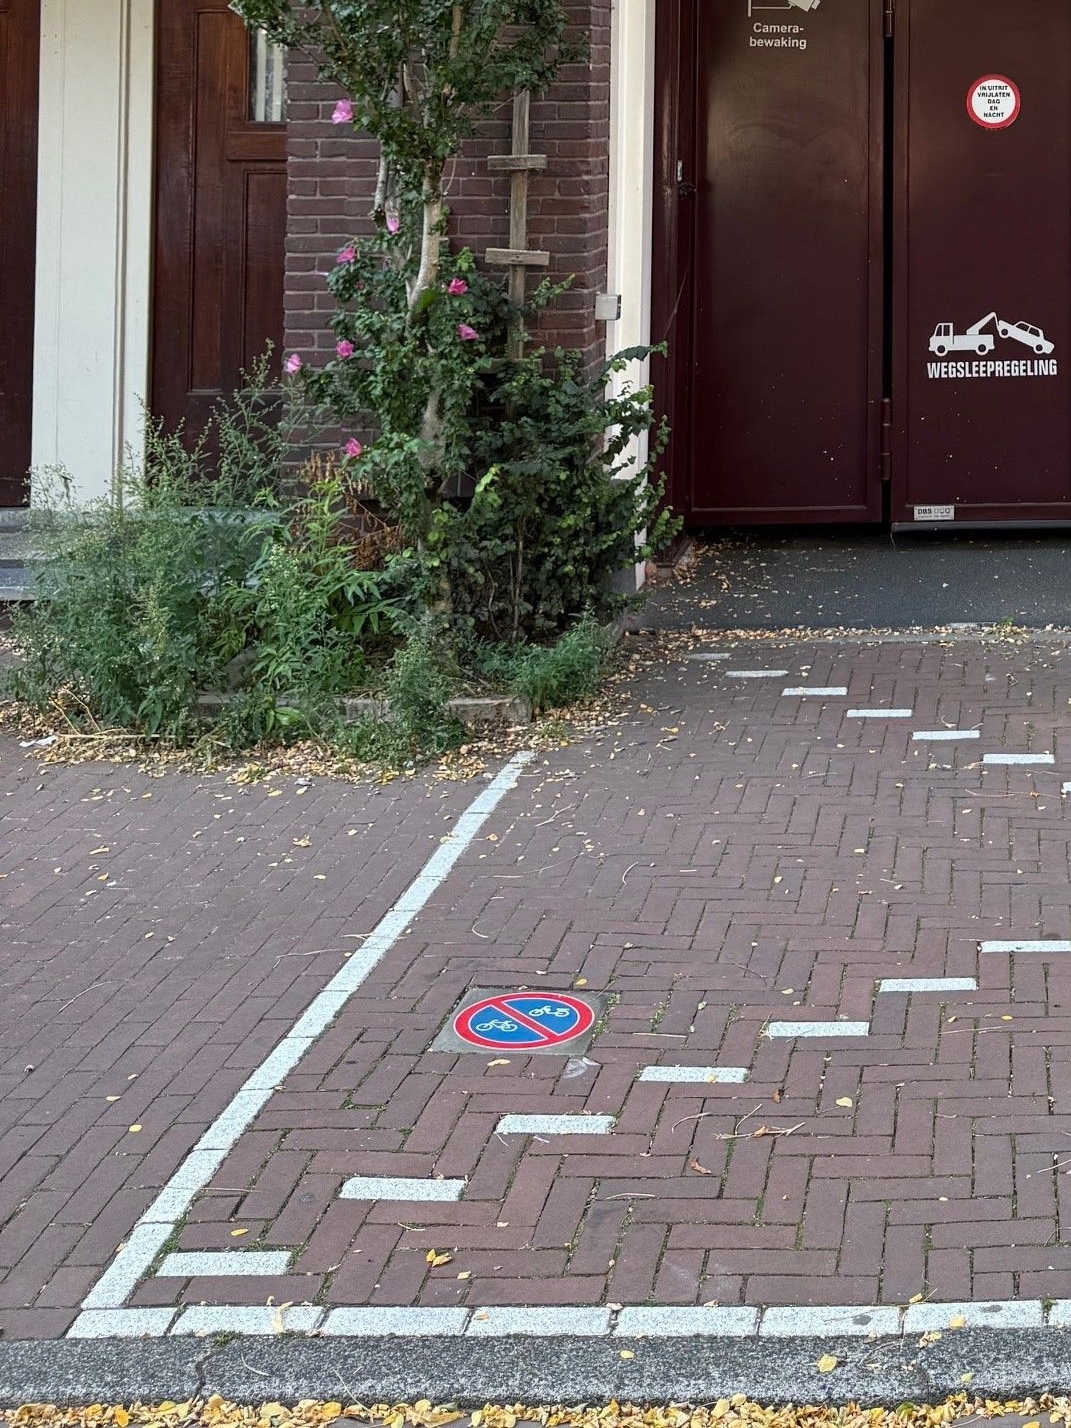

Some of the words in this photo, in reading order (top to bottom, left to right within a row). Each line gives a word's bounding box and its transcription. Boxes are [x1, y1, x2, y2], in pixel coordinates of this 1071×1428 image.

[753, 22, 804, 33] Camera-
[749, 36, 807, 50] bewaking
[927, 359, 1058, 379] WEGSLEEPREGELING
